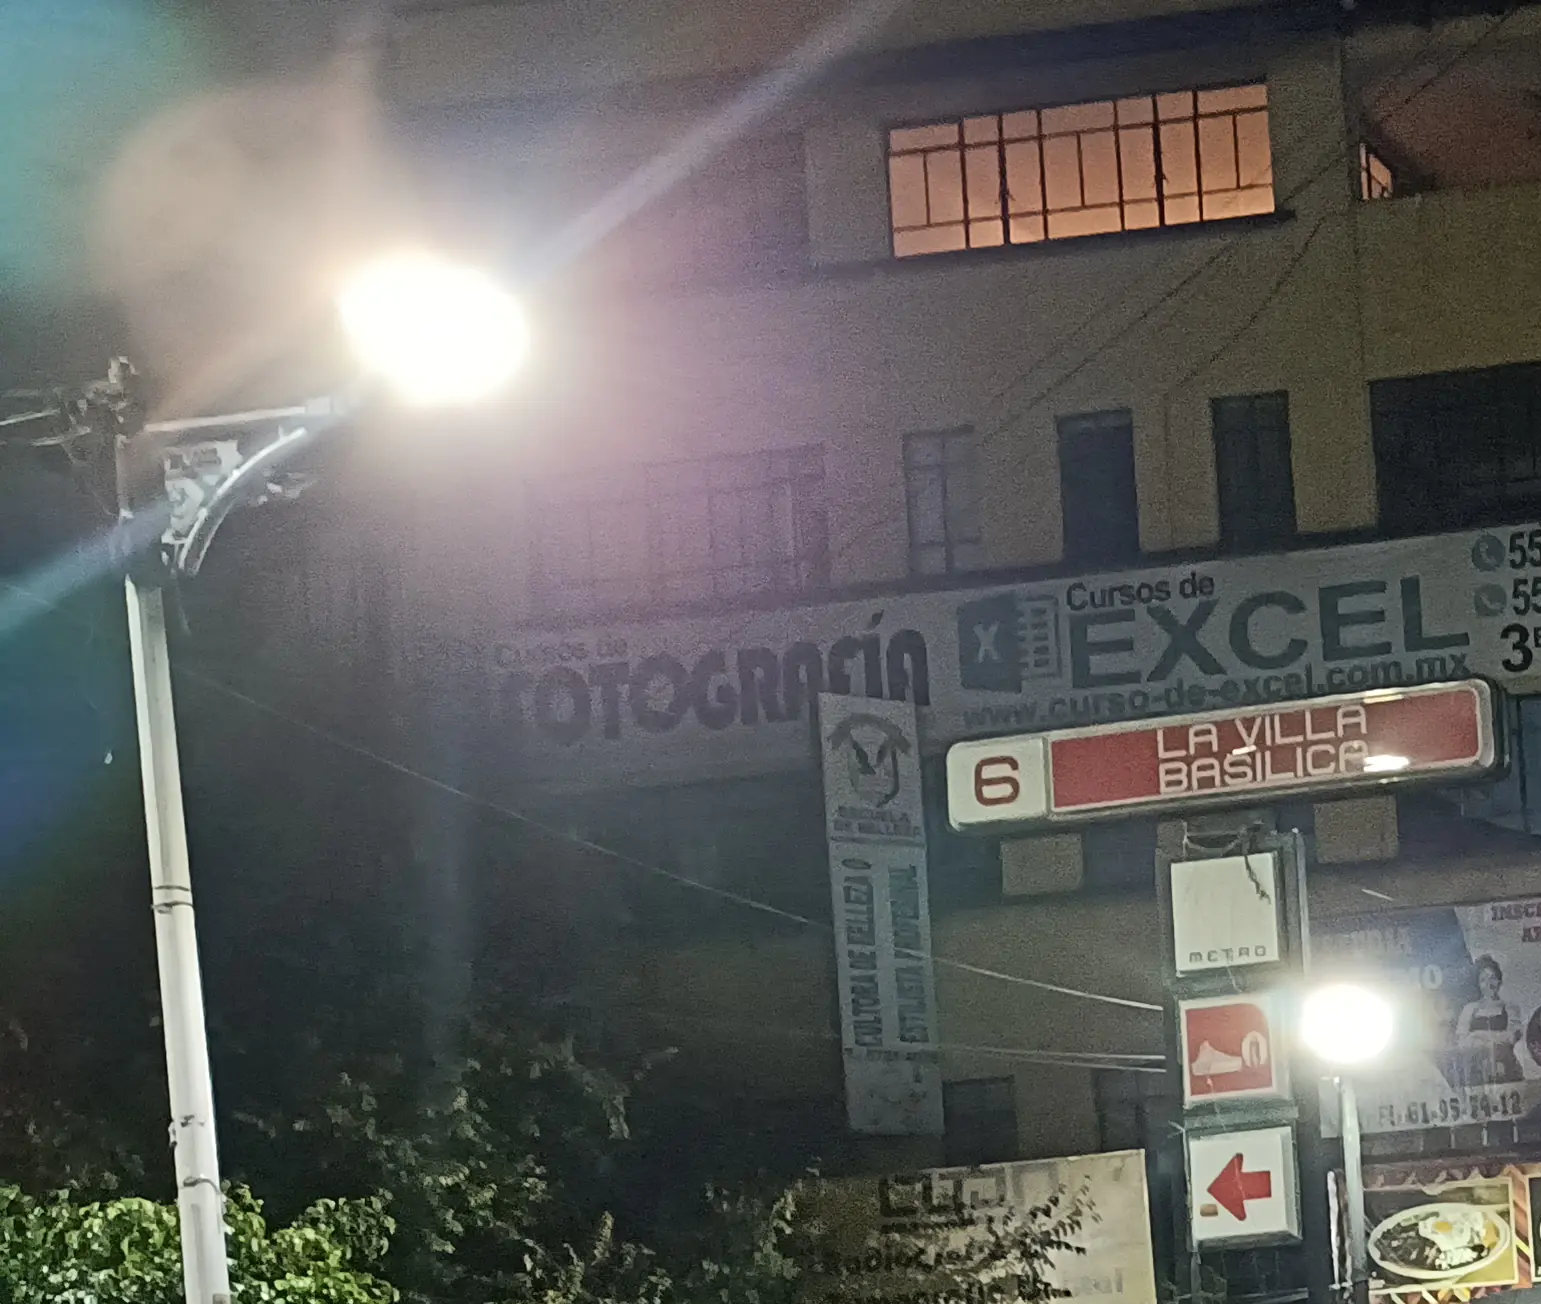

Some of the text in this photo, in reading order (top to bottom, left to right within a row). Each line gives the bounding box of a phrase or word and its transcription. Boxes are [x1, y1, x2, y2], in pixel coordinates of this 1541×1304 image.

[1066, 571, 1215, 611] Cursos de
[1069, 574, 1470, 688] EXCEL
[1156, 704, 1369, 760] LA VILLA
[974, 755, 1021, 806] 6
[1157, 740, 1371, 796] BASILICA
[1188, 944, 1267, 965] METRO
